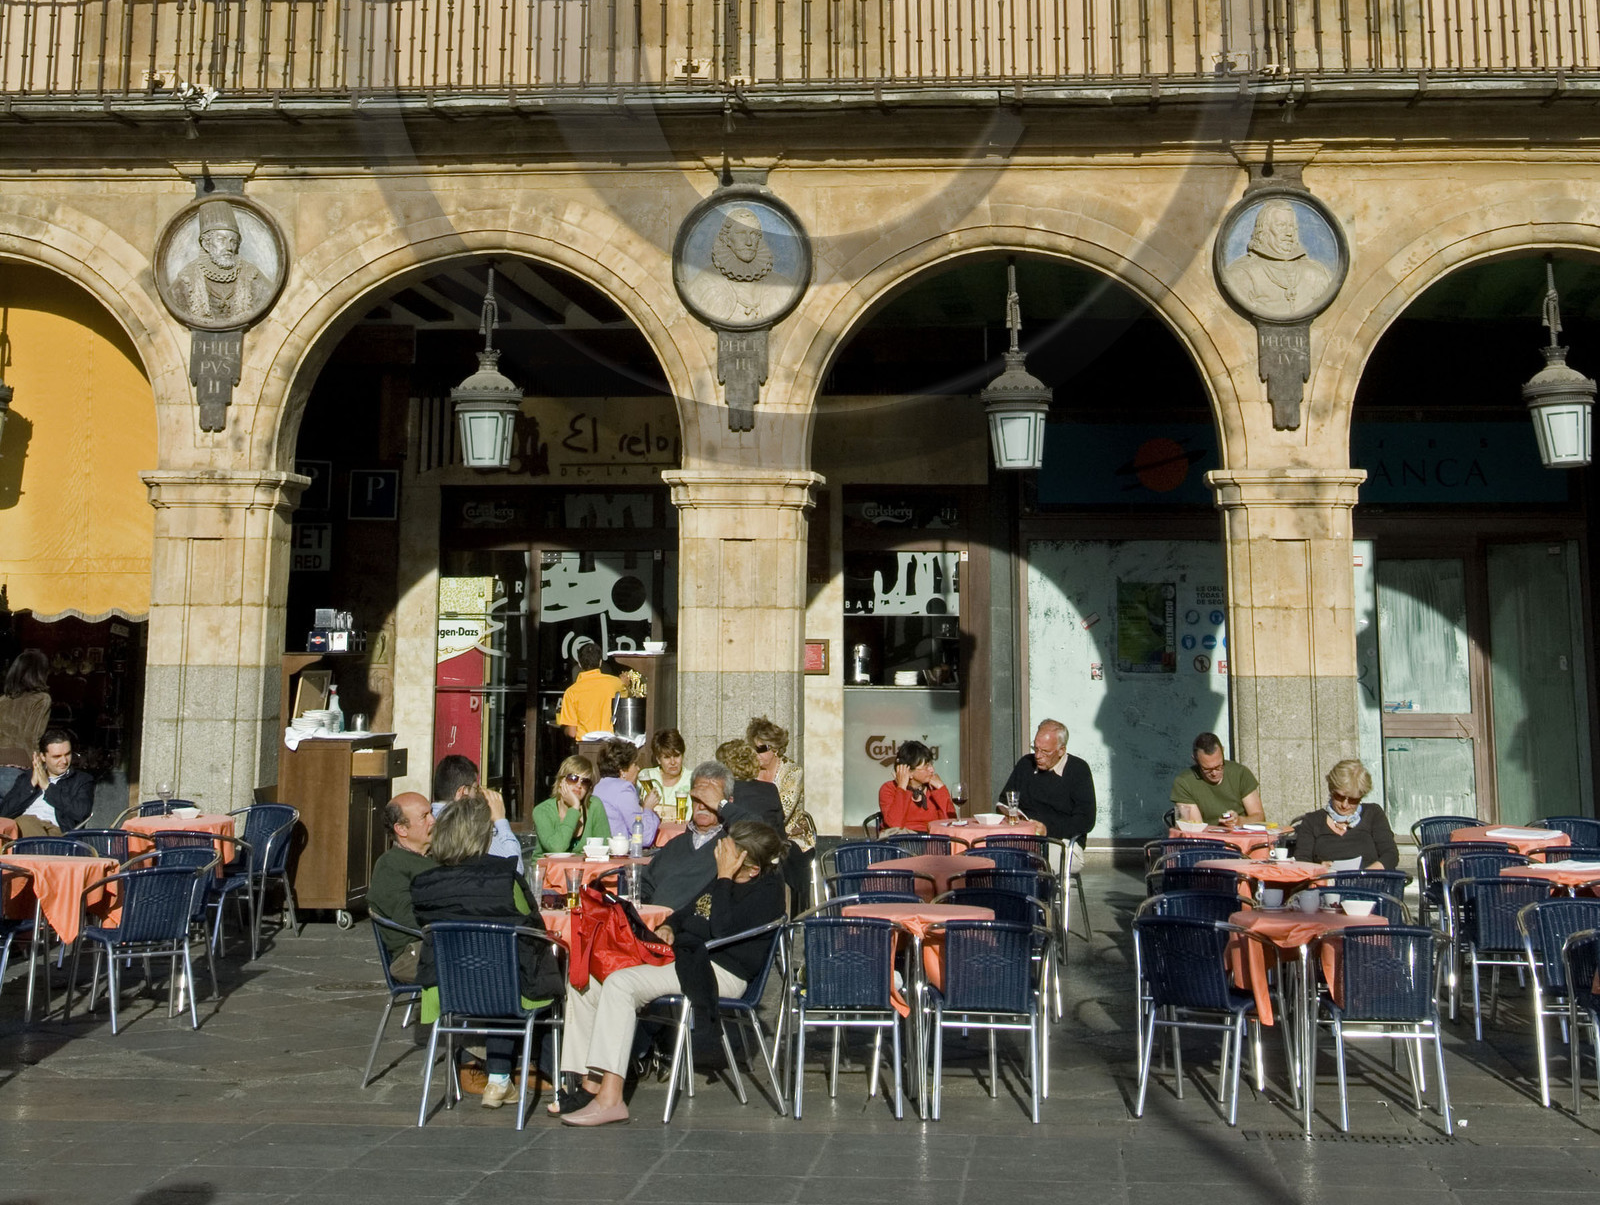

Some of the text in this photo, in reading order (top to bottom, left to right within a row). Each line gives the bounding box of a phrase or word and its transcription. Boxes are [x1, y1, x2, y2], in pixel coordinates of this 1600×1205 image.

[200, 361, 231, 375] PVS
[208, 379, 221, 394] II
[562, 413, 598, 453] El
[1369, 457, 1488, 487] ANCA
[862, 502, 913, 522] Carlsberg
[294, 555, 322, 569] RED
[845, 600, 874, 609] BAR
[865, 735, 940, 763] Carlg
